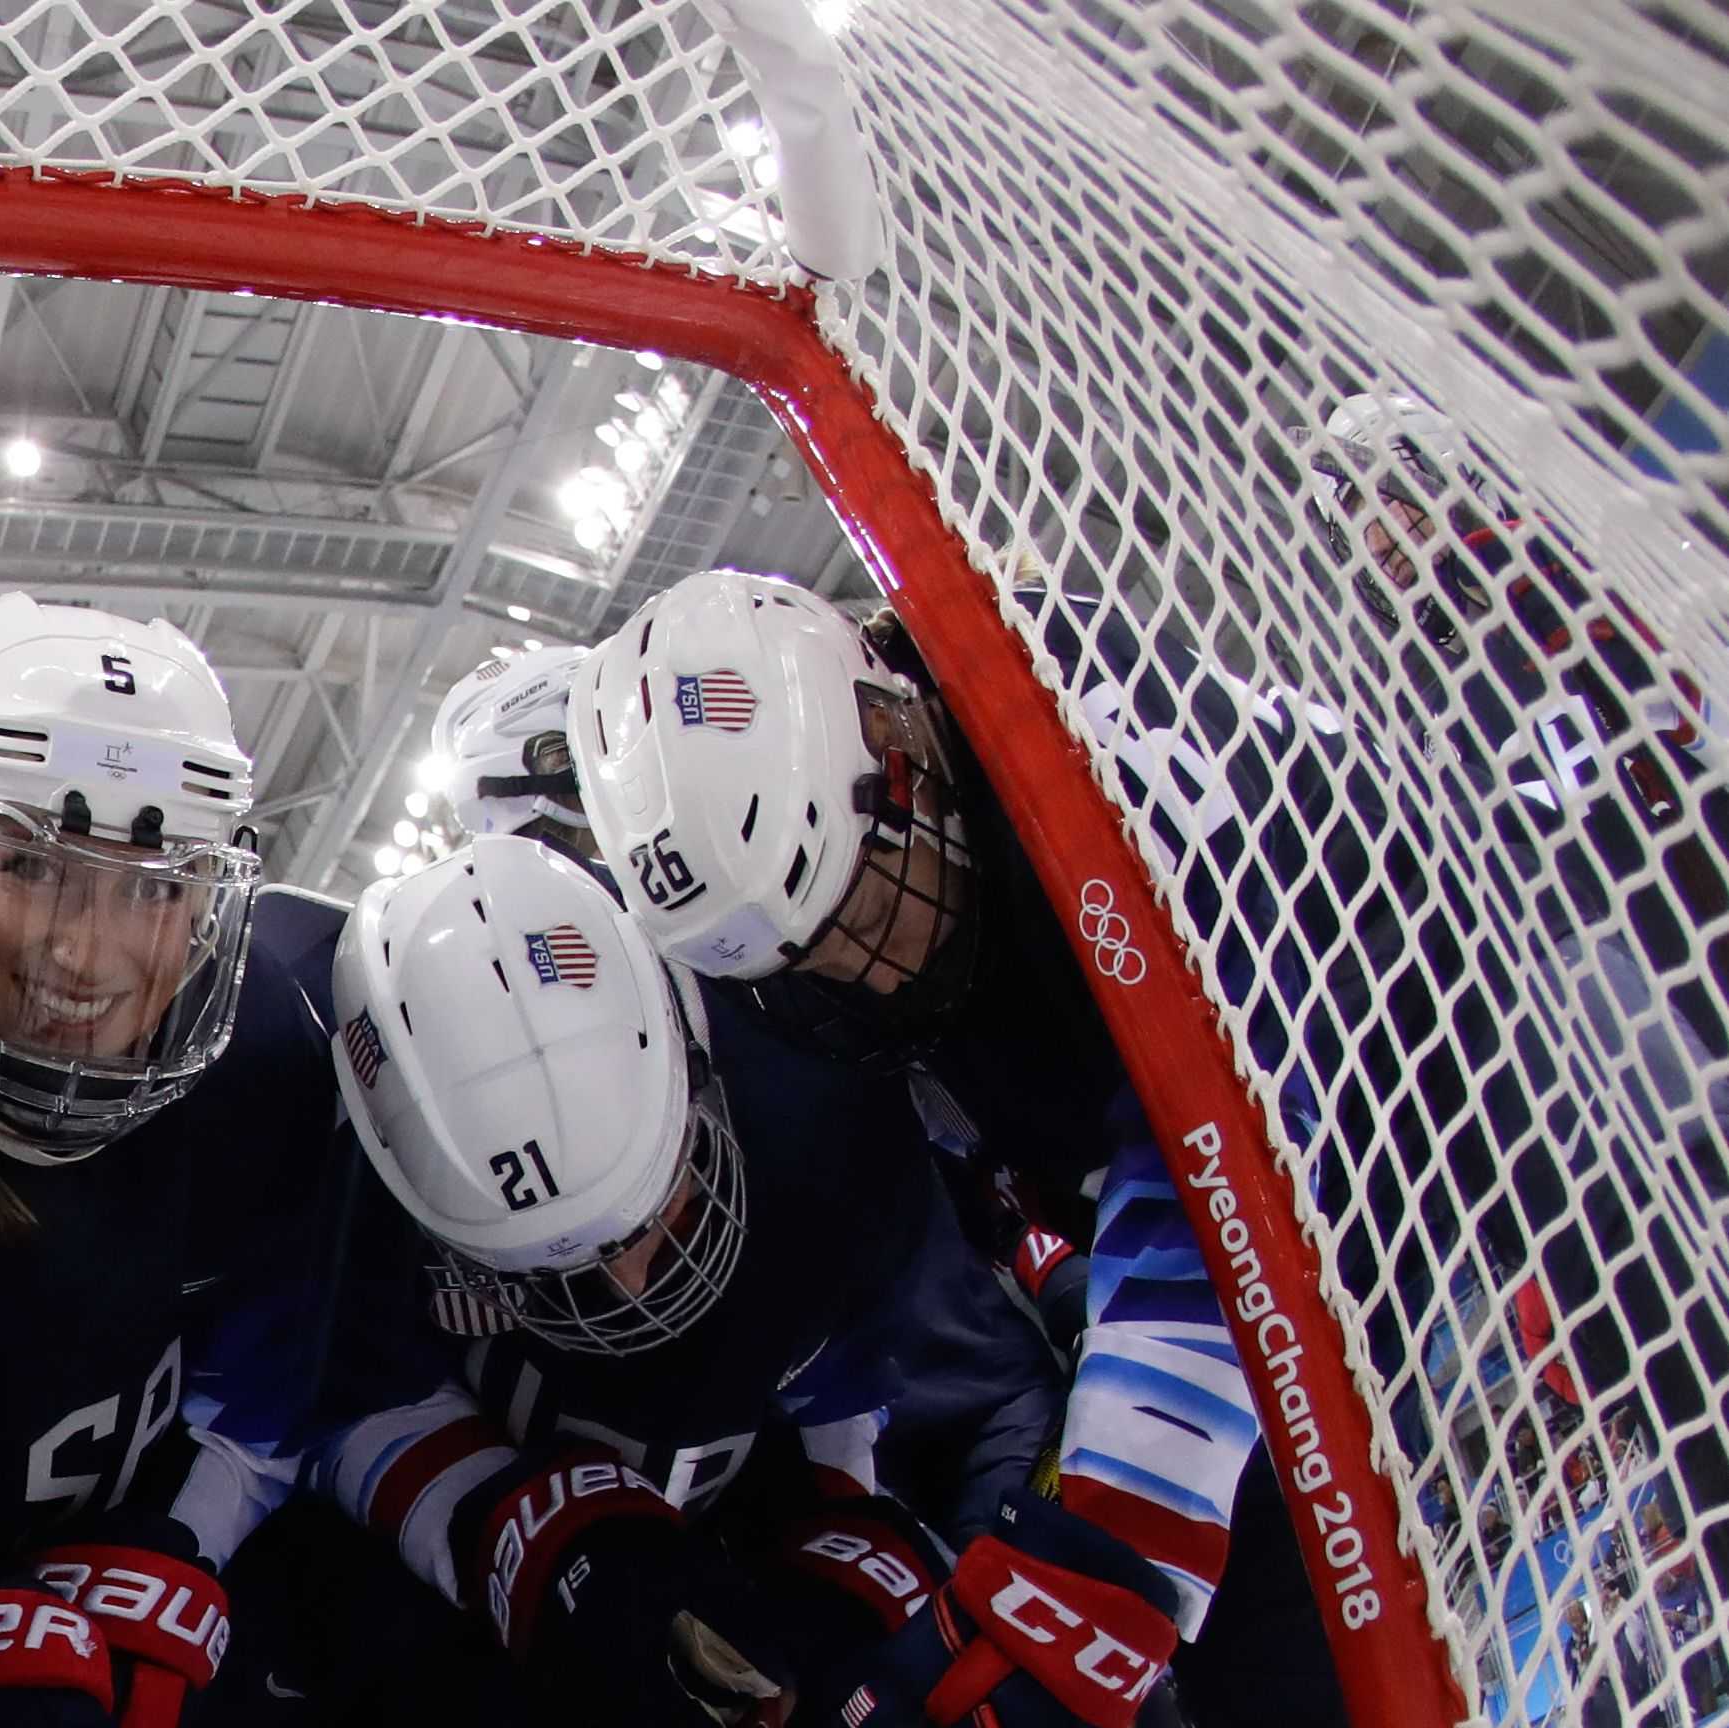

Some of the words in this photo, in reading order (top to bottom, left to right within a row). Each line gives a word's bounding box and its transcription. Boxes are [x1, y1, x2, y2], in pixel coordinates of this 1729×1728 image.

[101, 654, 136, 696] 5
[681, 675, 701, 726] USA
[629, 828, 696, 905] 26
[529, 939, 554, 979] USA
[488, 1138, 561, 1212] 21
[1182, 1120, 1334, 1495] PyeongChang
[1312, 1490, 1382, 1631] 2018
[38, 1562, 231, 1681] BAUE
